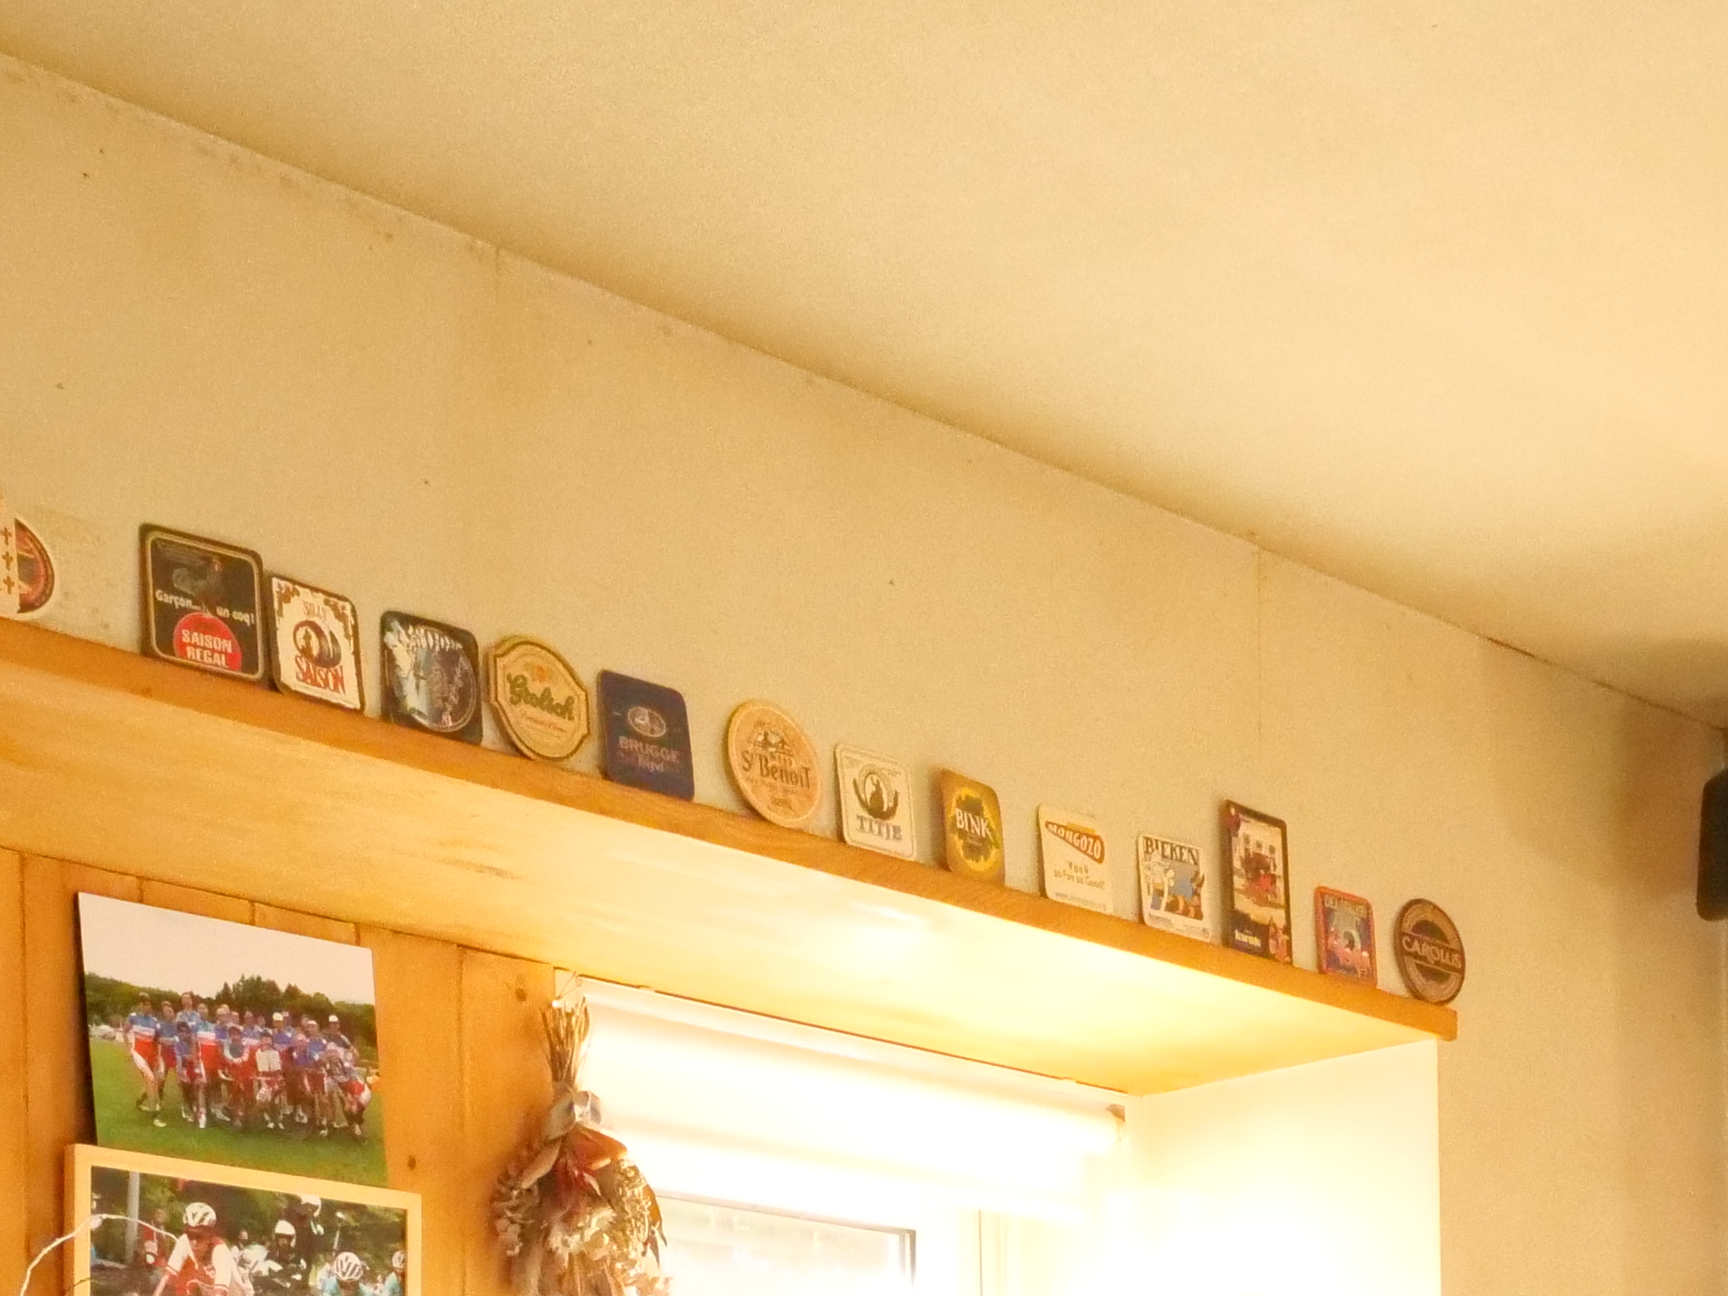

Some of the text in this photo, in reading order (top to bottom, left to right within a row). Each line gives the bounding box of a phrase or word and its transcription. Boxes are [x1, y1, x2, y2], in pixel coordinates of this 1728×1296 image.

[181, 628, 233, 654] SAISON
[294, 653, 347, 696] SAISON
[856, 813, 904, 842] TITJE
[955, 807, 994, 843] BINK
[1047, 822, 1103, 861] MONGOZO
[1143, 836, 1201, 867] BIEKEN
[1401, 935, 1462, 970] CAROLUS
